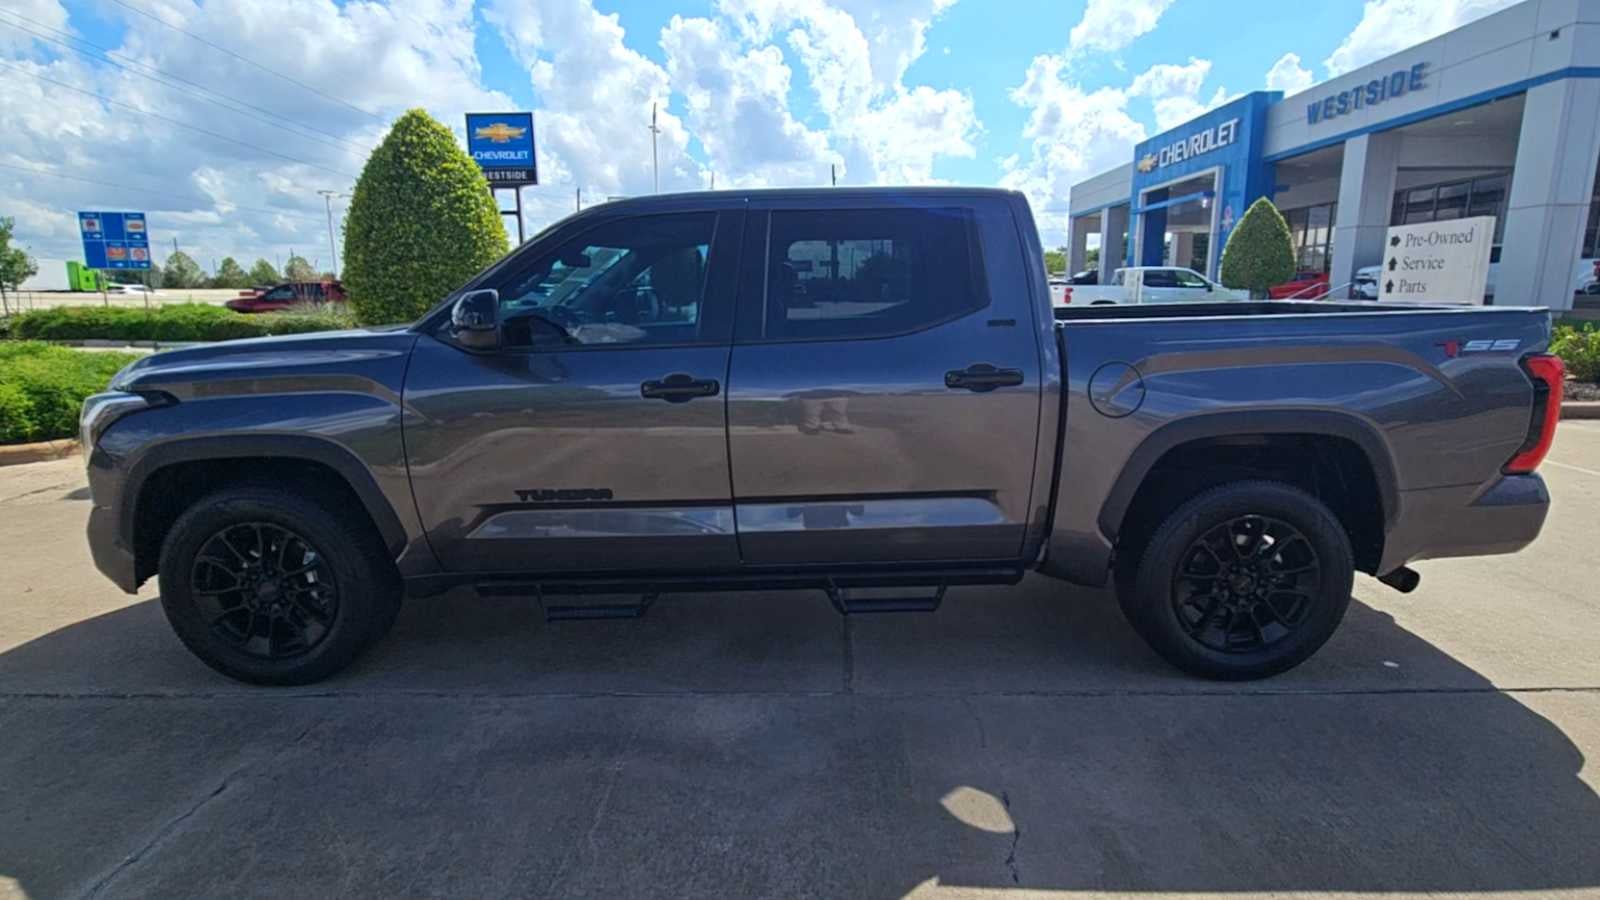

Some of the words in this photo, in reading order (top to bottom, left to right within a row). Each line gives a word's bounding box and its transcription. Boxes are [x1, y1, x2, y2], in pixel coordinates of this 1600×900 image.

[1307, 61, 1427, 125] WESTSIDE
[1159, 118, 1239, 168] CHEVROLET
[473, 150, 529, 160] CHEVROLET
[482, 170, 528, 180] ESTSIDE
[1405, 226, 1474, 248] Pre-Owned
[1401, 255, 1446, 271] Service
[1399, 279, 1427, 294] Parts
[513, 488, 614, 502] TUNDRA
